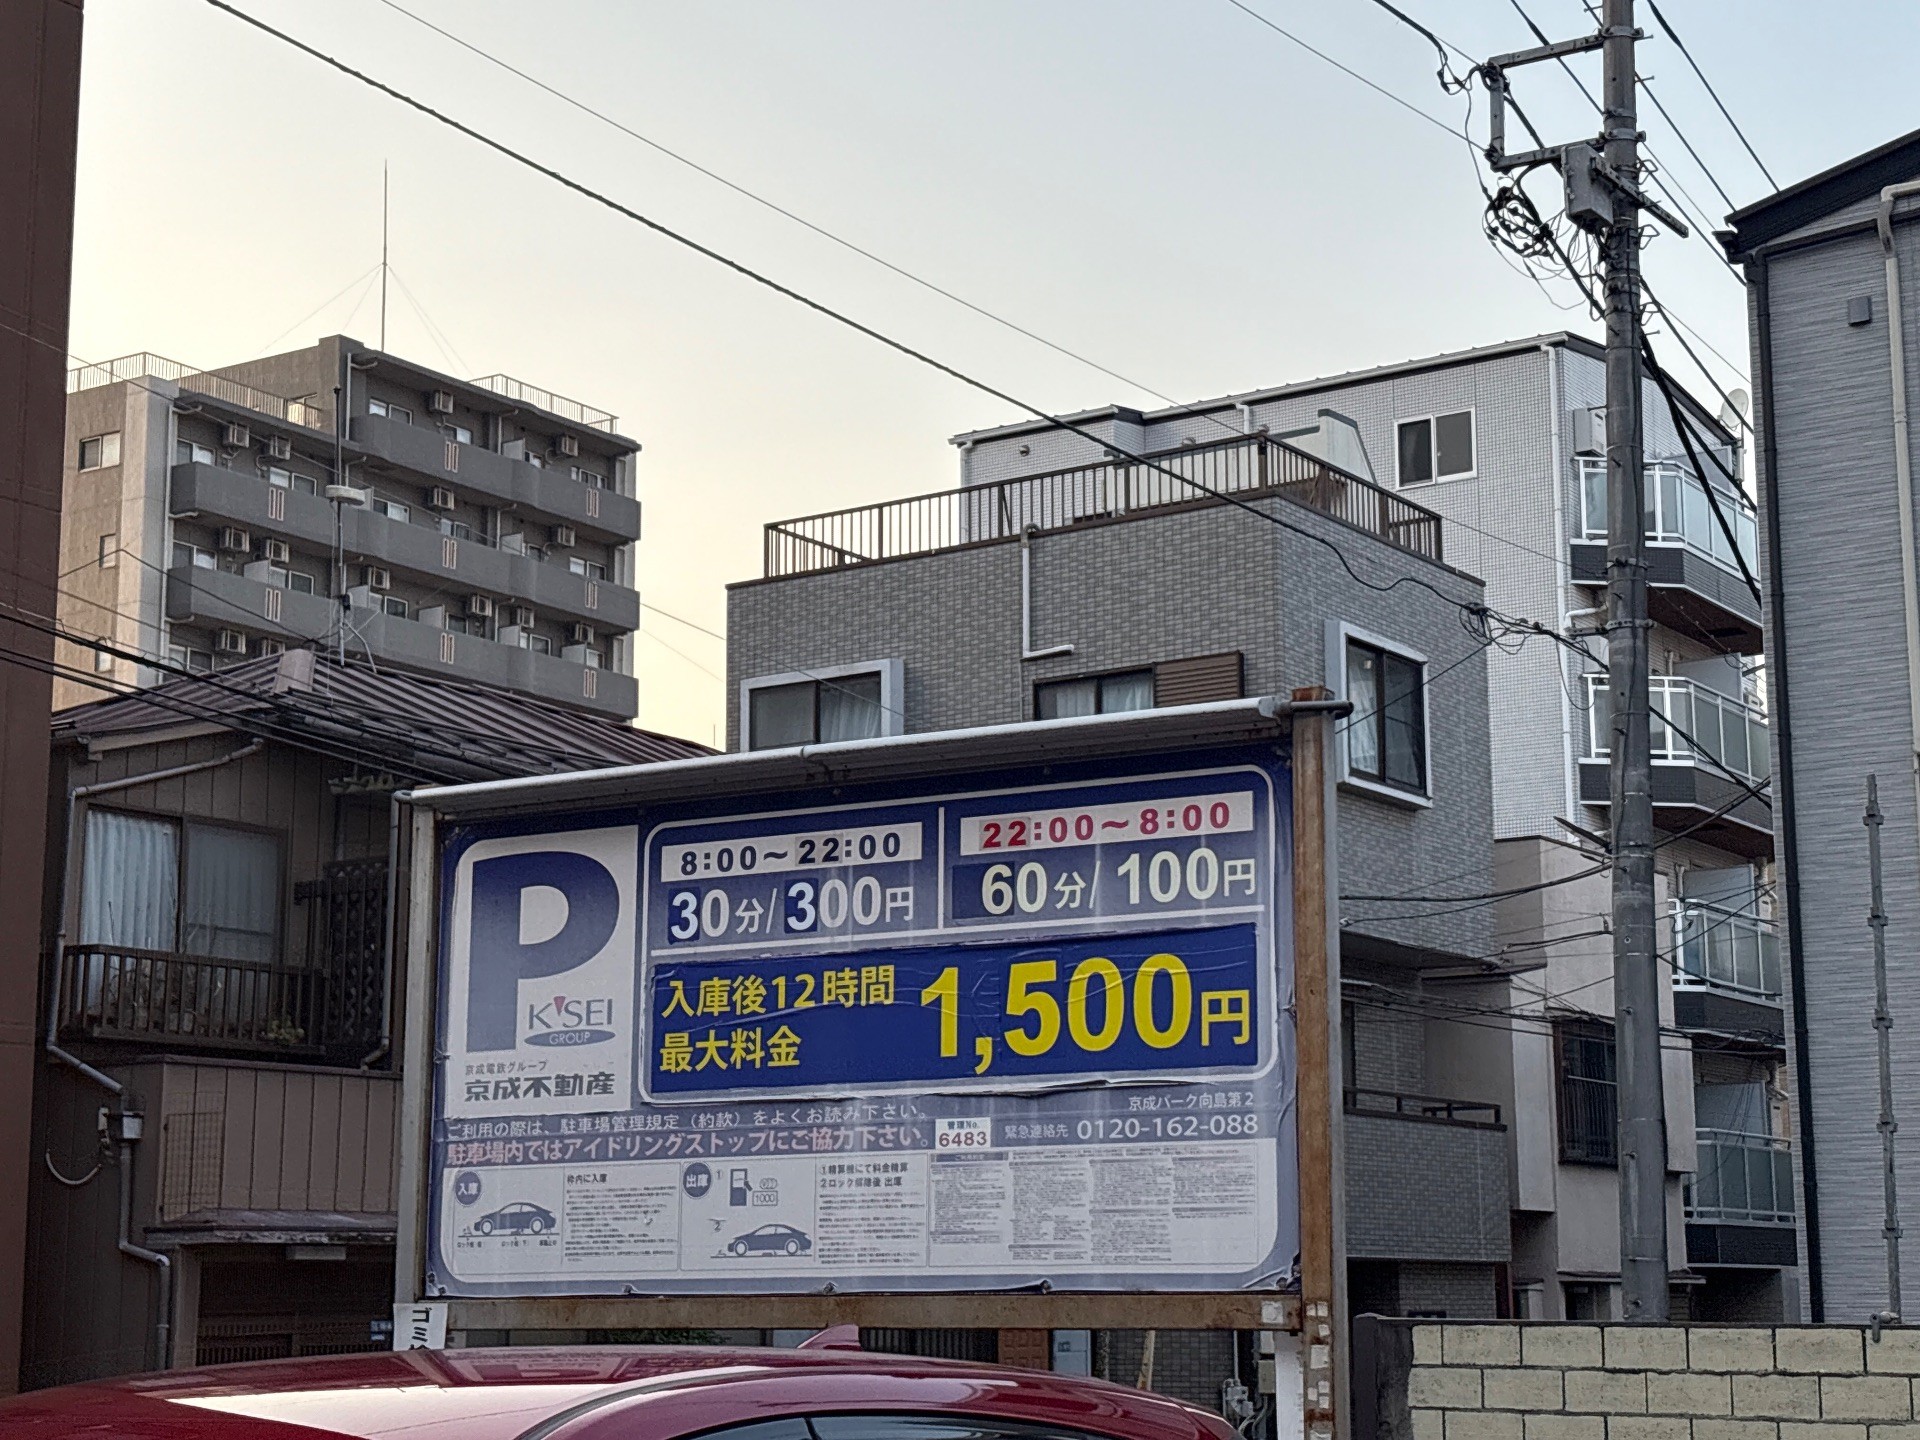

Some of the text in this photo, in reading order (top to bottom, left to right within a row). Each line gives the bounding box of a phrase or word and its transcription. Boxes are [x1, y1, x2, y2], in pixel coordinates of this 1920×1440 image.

[466, 851, 620, 1053] P
[661, 964, 896, 1018] 入庫後12時間
[920, 953, 1251, 1075] 1,500円
[549, 1031, 591, 1045] GROUP
[659, 1025, 802, 1074] 最大料金
[465, 1060, 548, 1075] 京成電鉄グループ
[464, 1071, 615, 1102] 京成不動産
[938, 1131, 987, 1148] 6483
[1004, 1114, 1259, 1140] 緊急連絡先 0120-162-088
[457, 1182, 479, 1196] 入庫
[685, 1173, 709, 1189] 出庫
